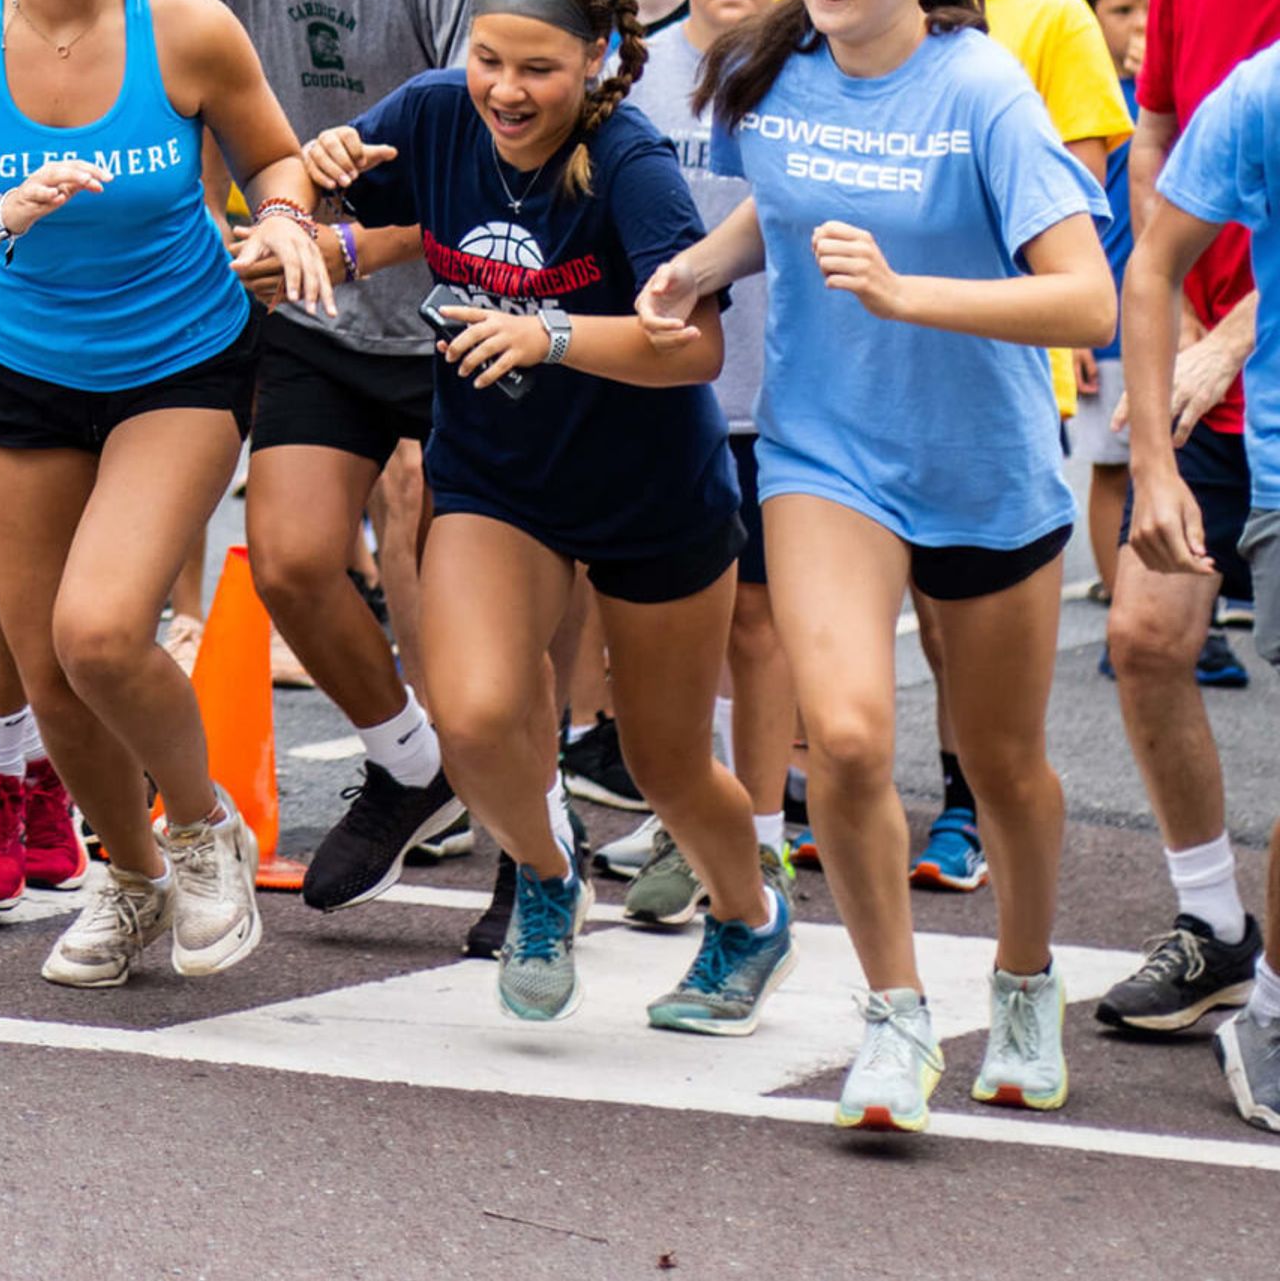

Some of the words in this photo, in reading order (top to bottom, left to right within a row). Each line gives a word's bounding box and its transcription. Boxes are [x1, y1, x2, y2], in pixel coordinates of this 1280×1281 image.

[739, 112, 970, 158] POWERHOUSE
[93, 137, 182, 177] MERE
[786, 152, 923, 193] SOCCER
